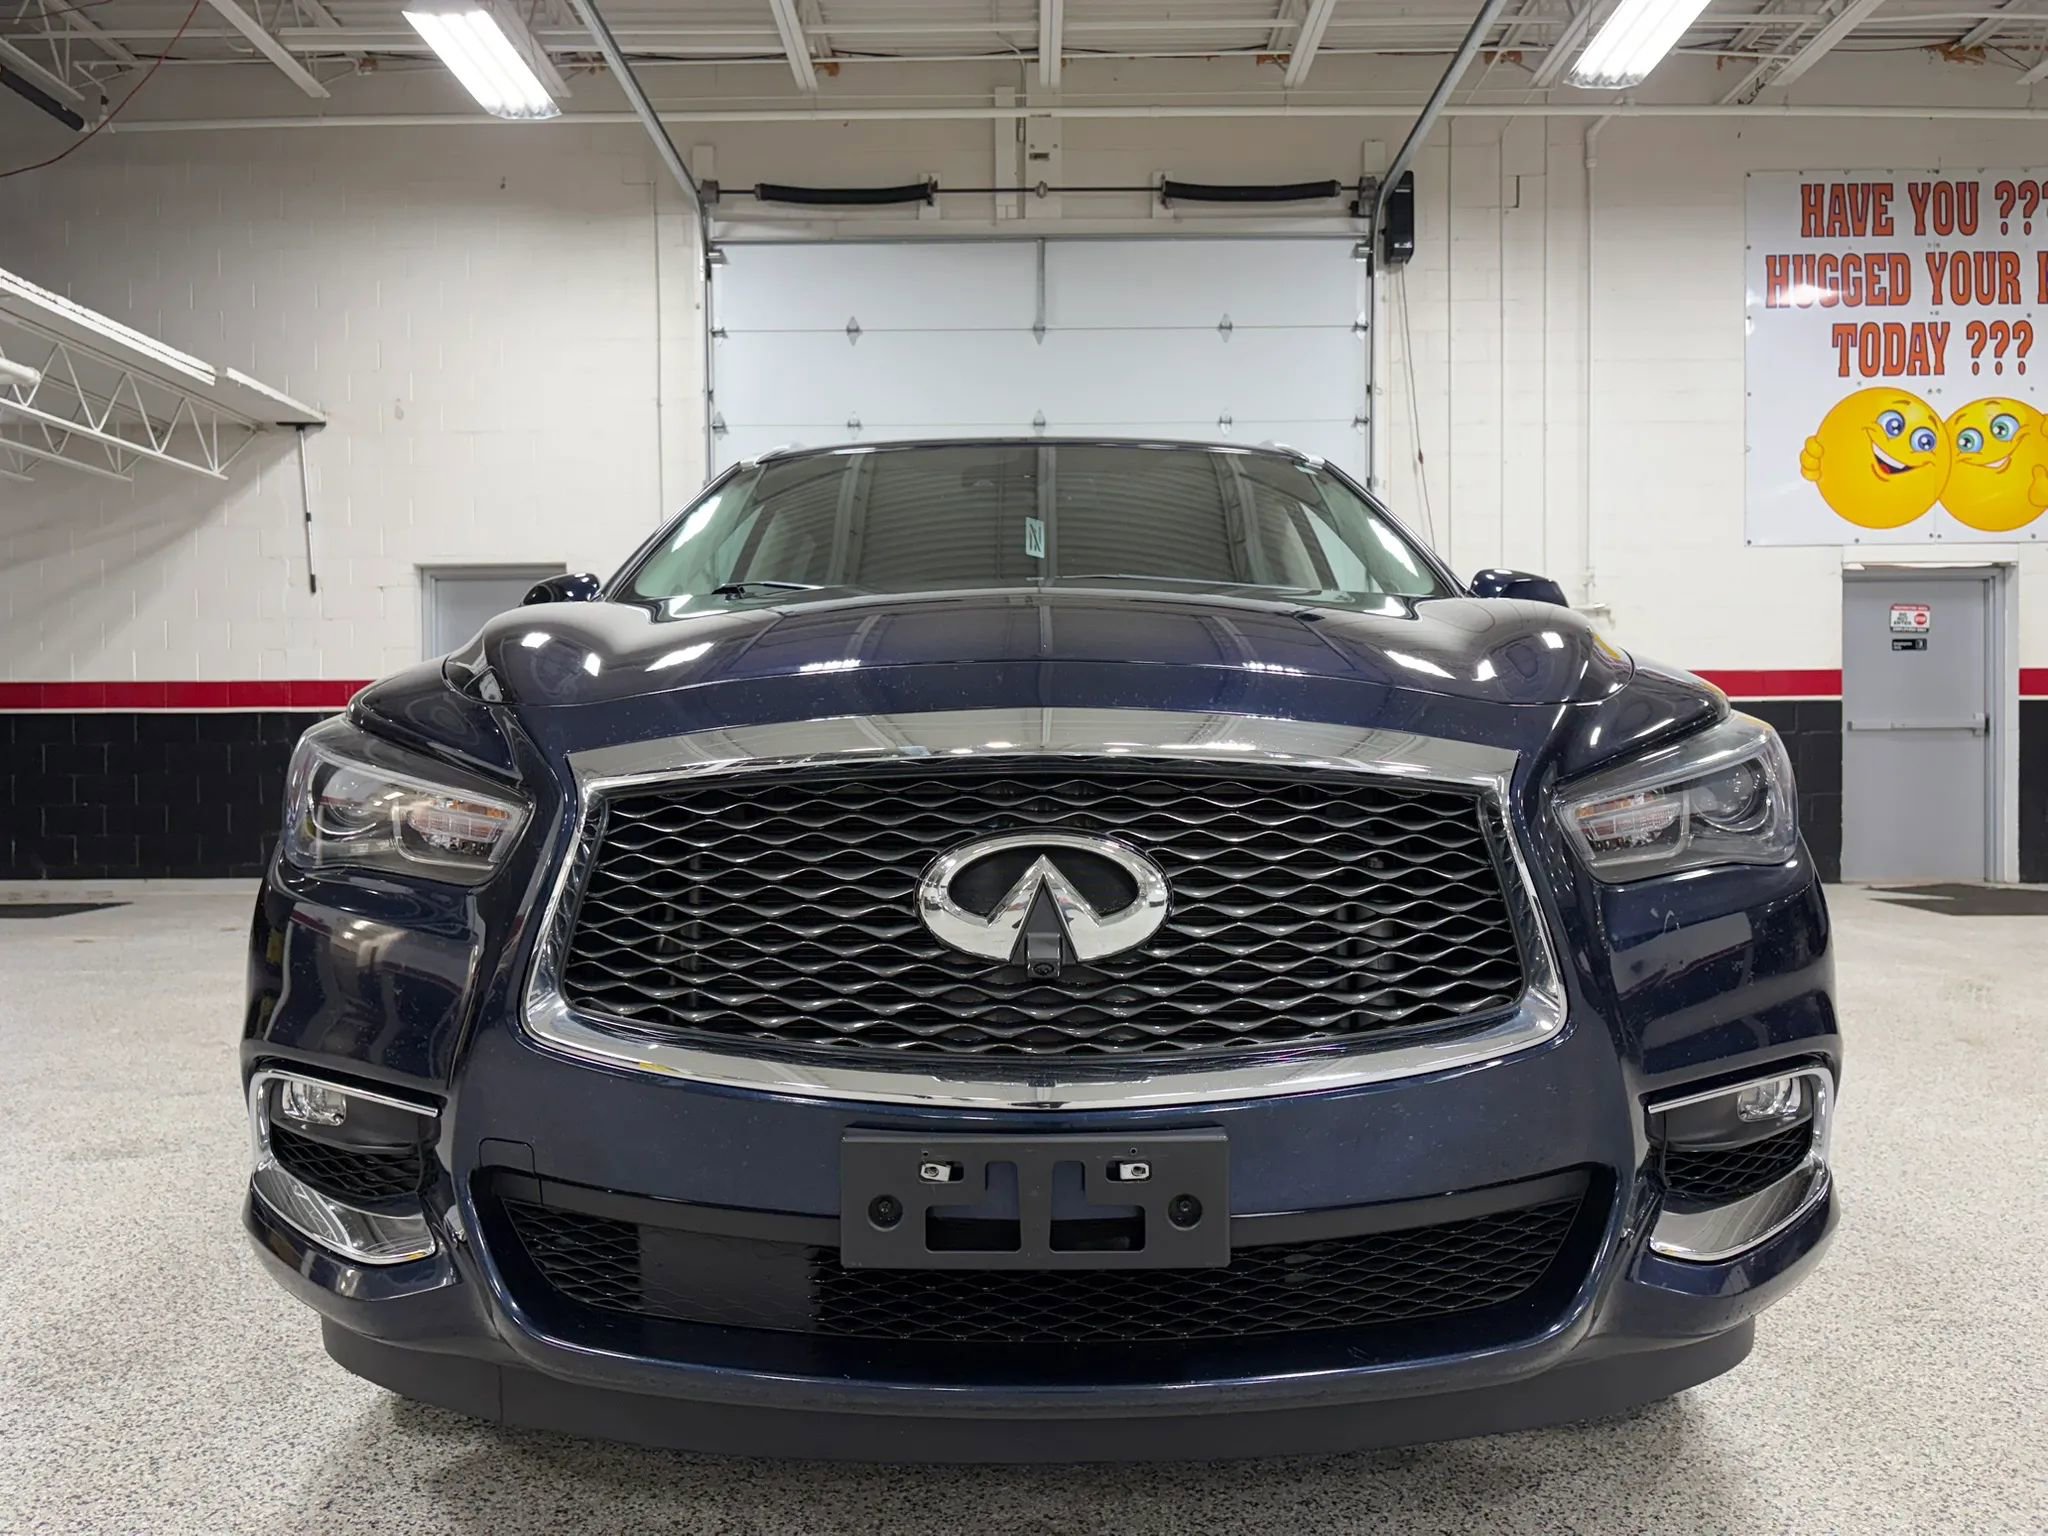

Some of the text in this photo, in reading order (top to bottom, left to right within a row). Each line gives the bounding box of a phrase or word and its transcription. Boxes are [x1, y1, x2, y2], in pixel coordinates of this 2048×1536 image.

[1800, 183, 1894, 237] HAVE
[1908, 180, 1979, 236] YOU
[1765, 253, 1910, 308] HUGGED
[1925, 250, 2021, 306] YOUR
[1832, 320, 2034, 378] TODAY ???
